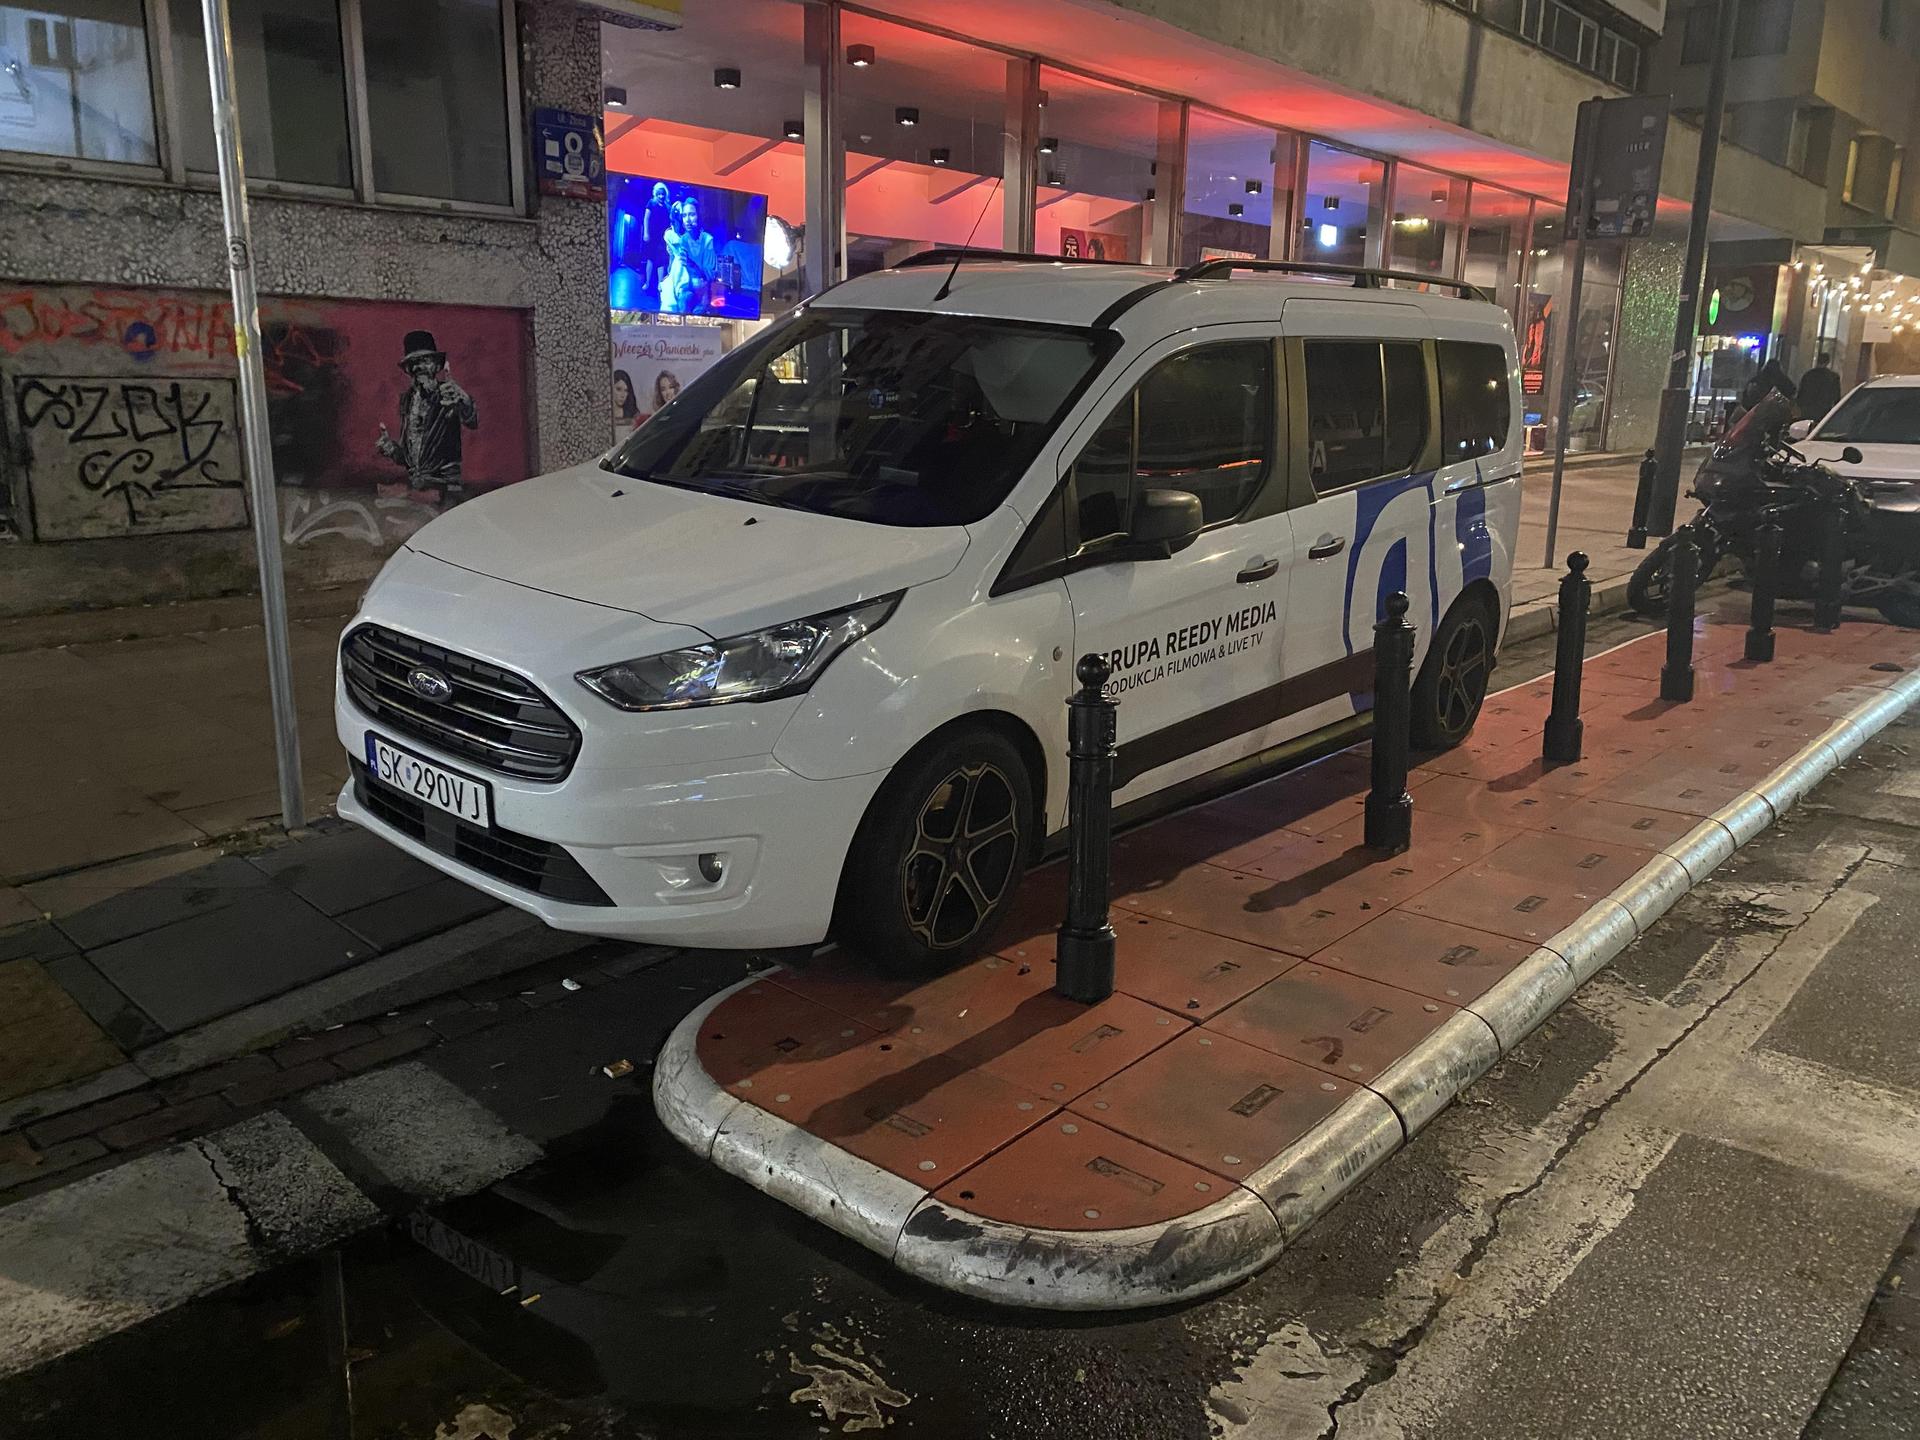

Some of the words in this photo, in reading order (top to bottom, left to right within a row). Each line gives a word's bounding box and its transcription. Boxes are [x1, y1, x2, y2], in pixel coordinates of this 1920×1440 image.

[1102, 638, 1161, 673] RUPA
[1166, 618, 1222, 655] REEDY
[1226, 601, 1276, 636] MEDIA
[1167, 649, 1216, 676] FILMOWA
[1218, 644, 1226, 658] &
[1228, 637, 1249, 655] LIVE
[1250, 632, 1263, 647] TV
[380, 747, 405, 787] SK
[412, 762, 479, 819] 290VJ
